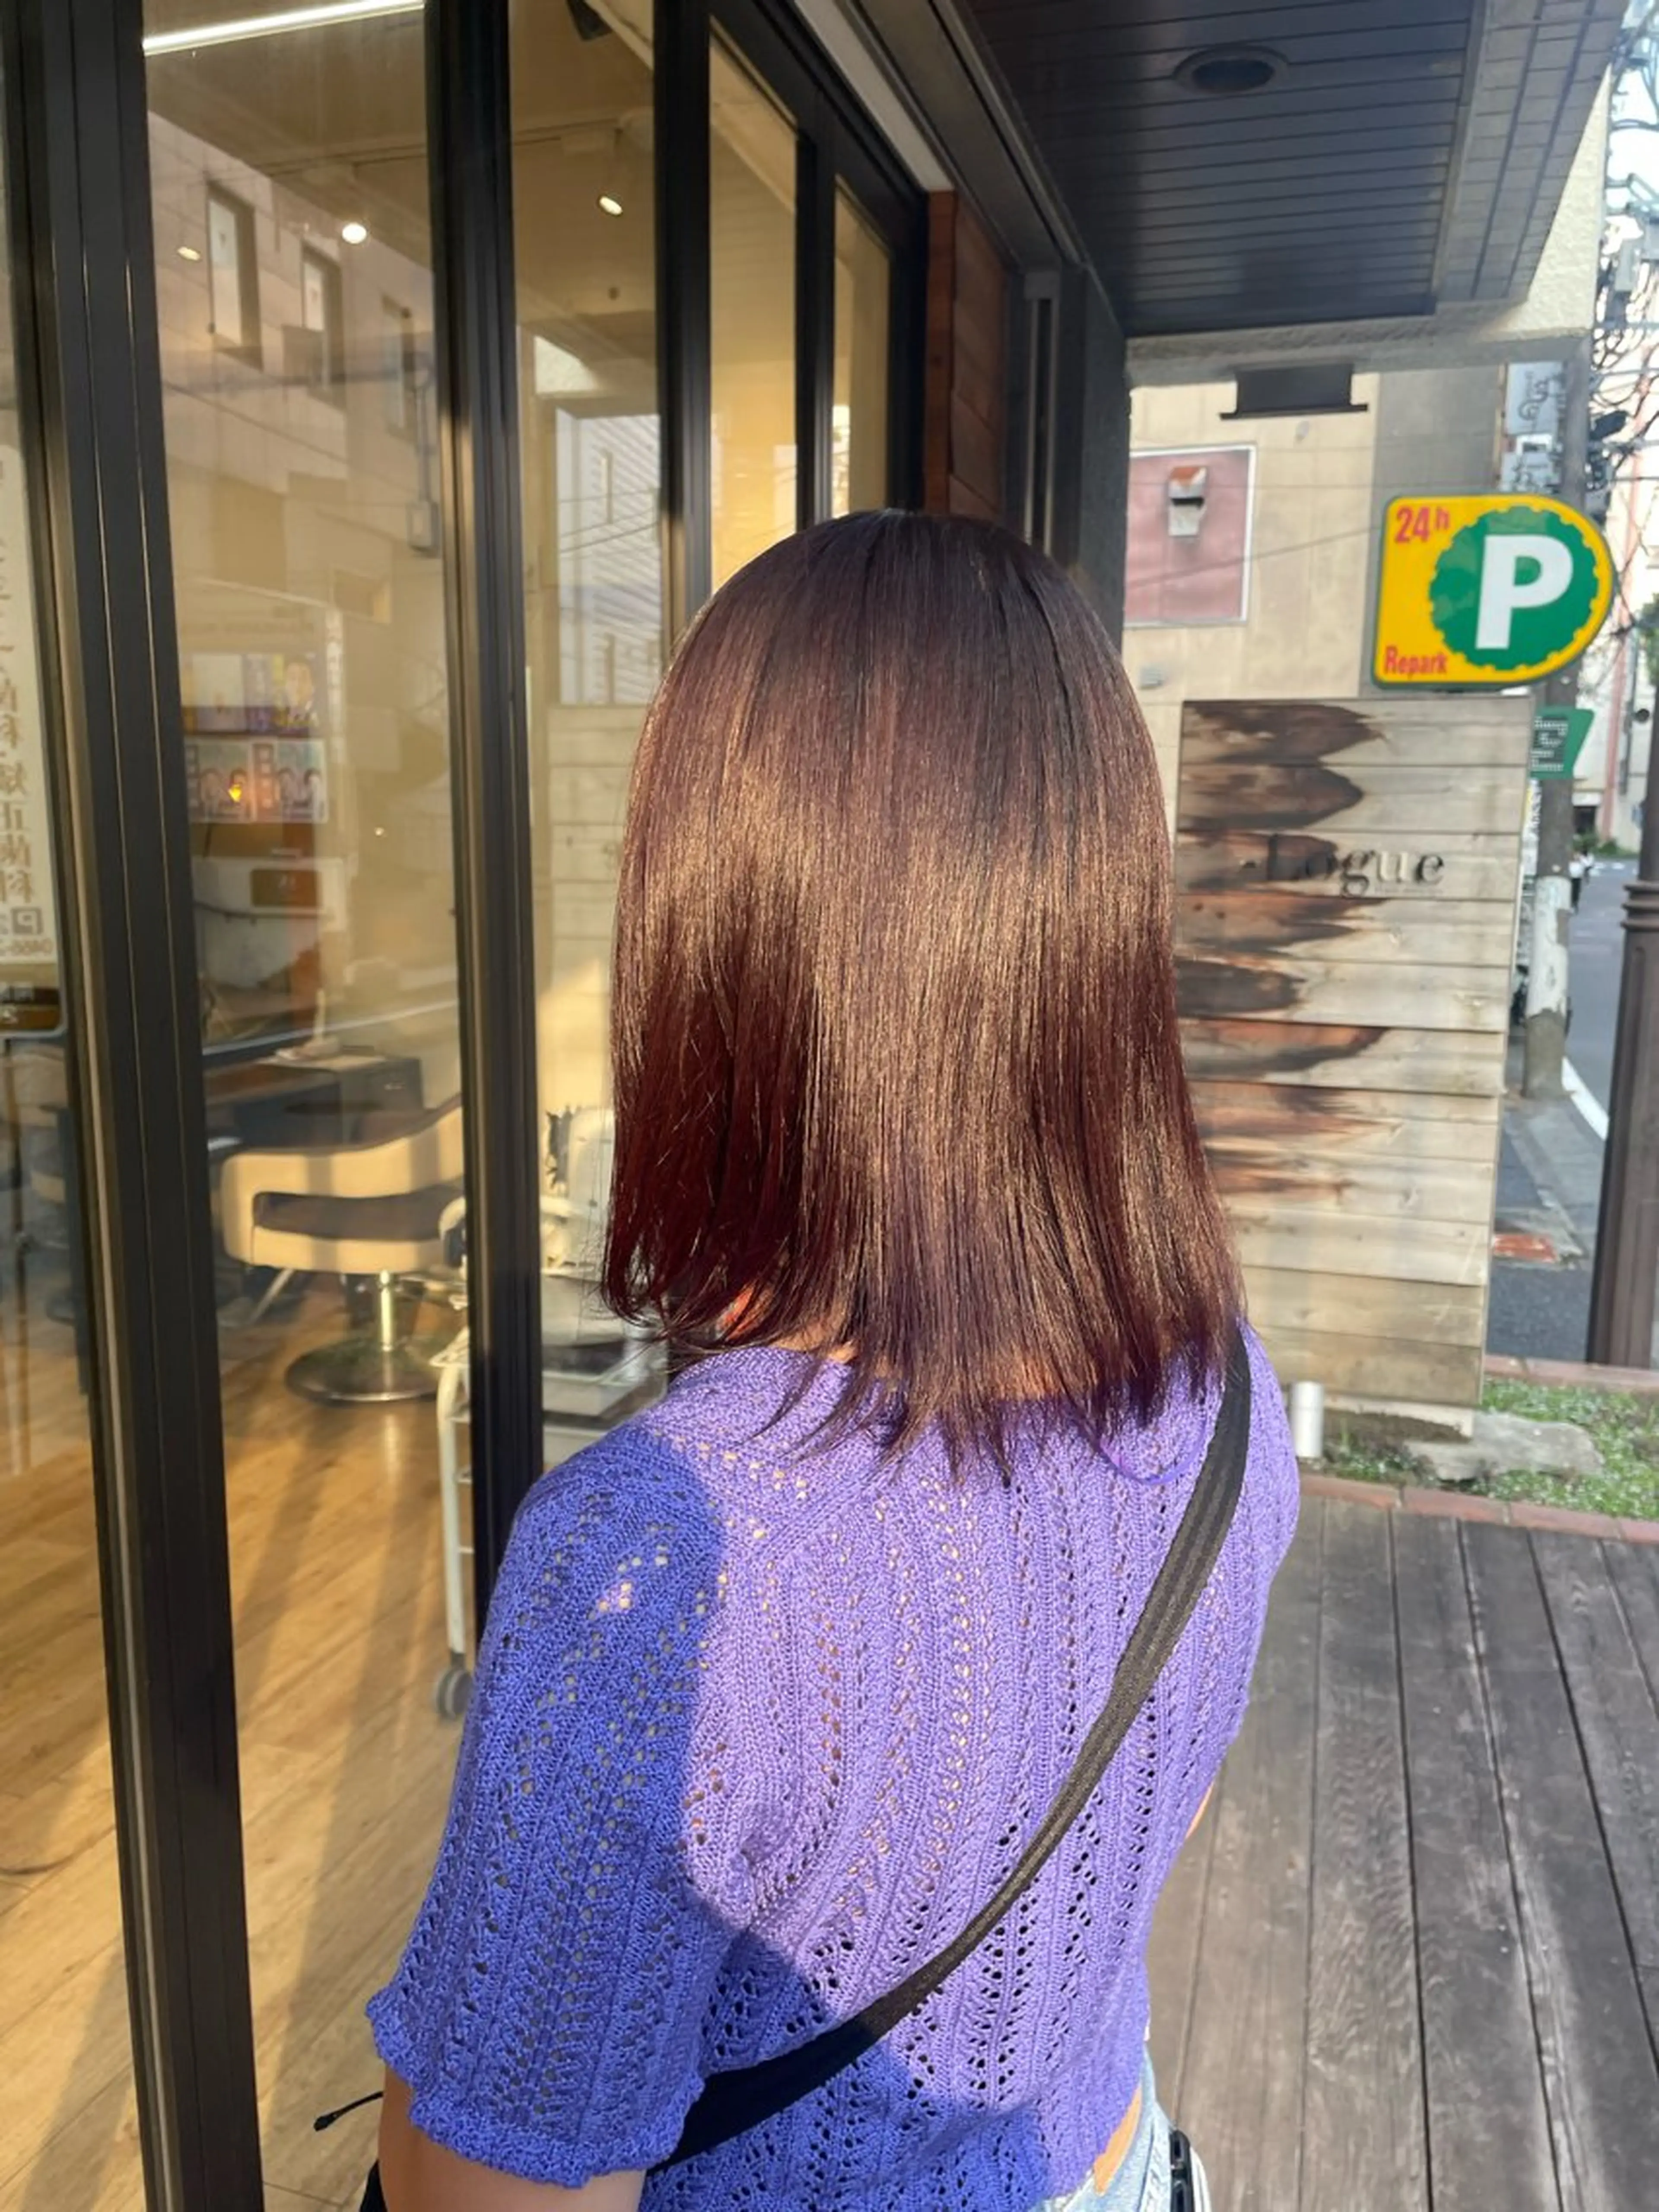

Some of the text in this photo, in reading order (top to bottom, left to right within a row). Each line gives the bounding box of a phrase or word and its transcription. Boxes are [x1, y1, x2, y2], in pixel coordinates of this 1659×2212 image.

[1395, 506, 1450, 543] 24h
[1475, 535, 1573, 649] P
[1383, 645, 1448, 680] Repark
